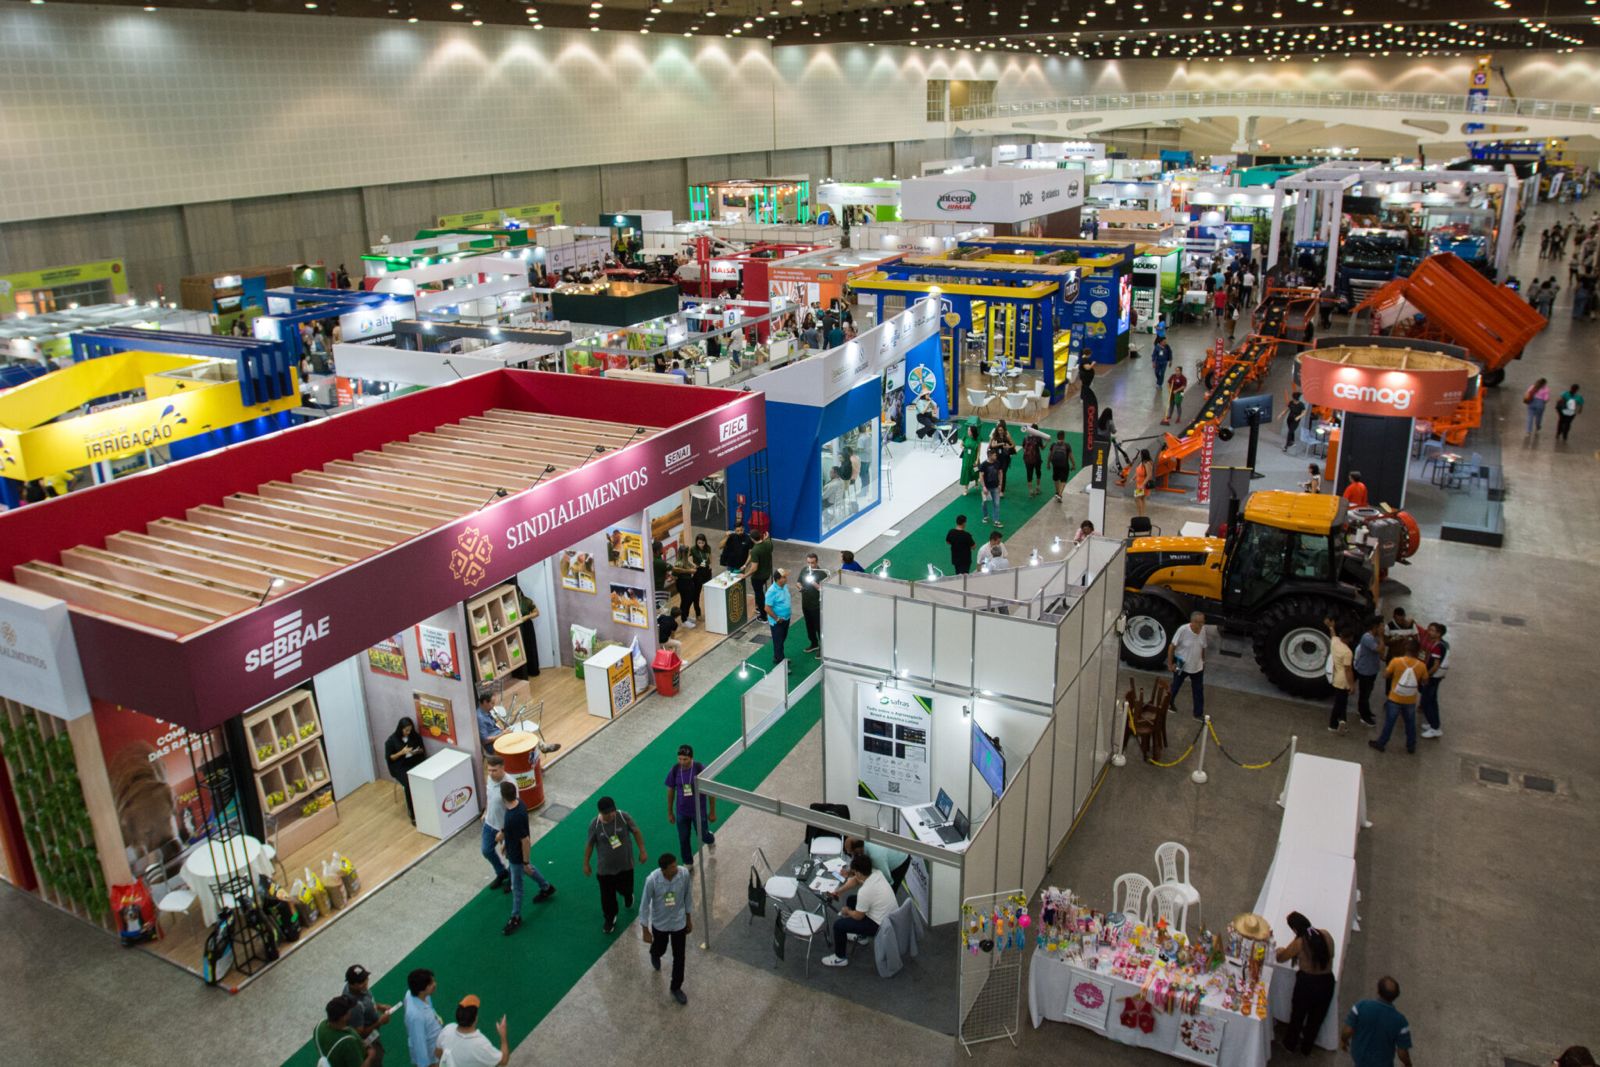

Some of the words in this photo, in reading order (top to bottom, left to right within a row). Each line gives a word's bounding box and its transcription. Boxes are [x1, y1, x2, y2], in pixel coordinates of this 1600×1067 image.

[1333, 383, 1411, 410] cemag
[723, 417, 745, 439] FIEC
[86, 424, 172, 459] IRRIGAÇÃO
[667, 446, 690, 465] SENAI
[506, 467, 649, 549] SINDIALIMENTOS
[245, 615, 330, 672] SEBRAE
[890, 698, 910, 709] safras
[148, 745, 170, 762] DAS
